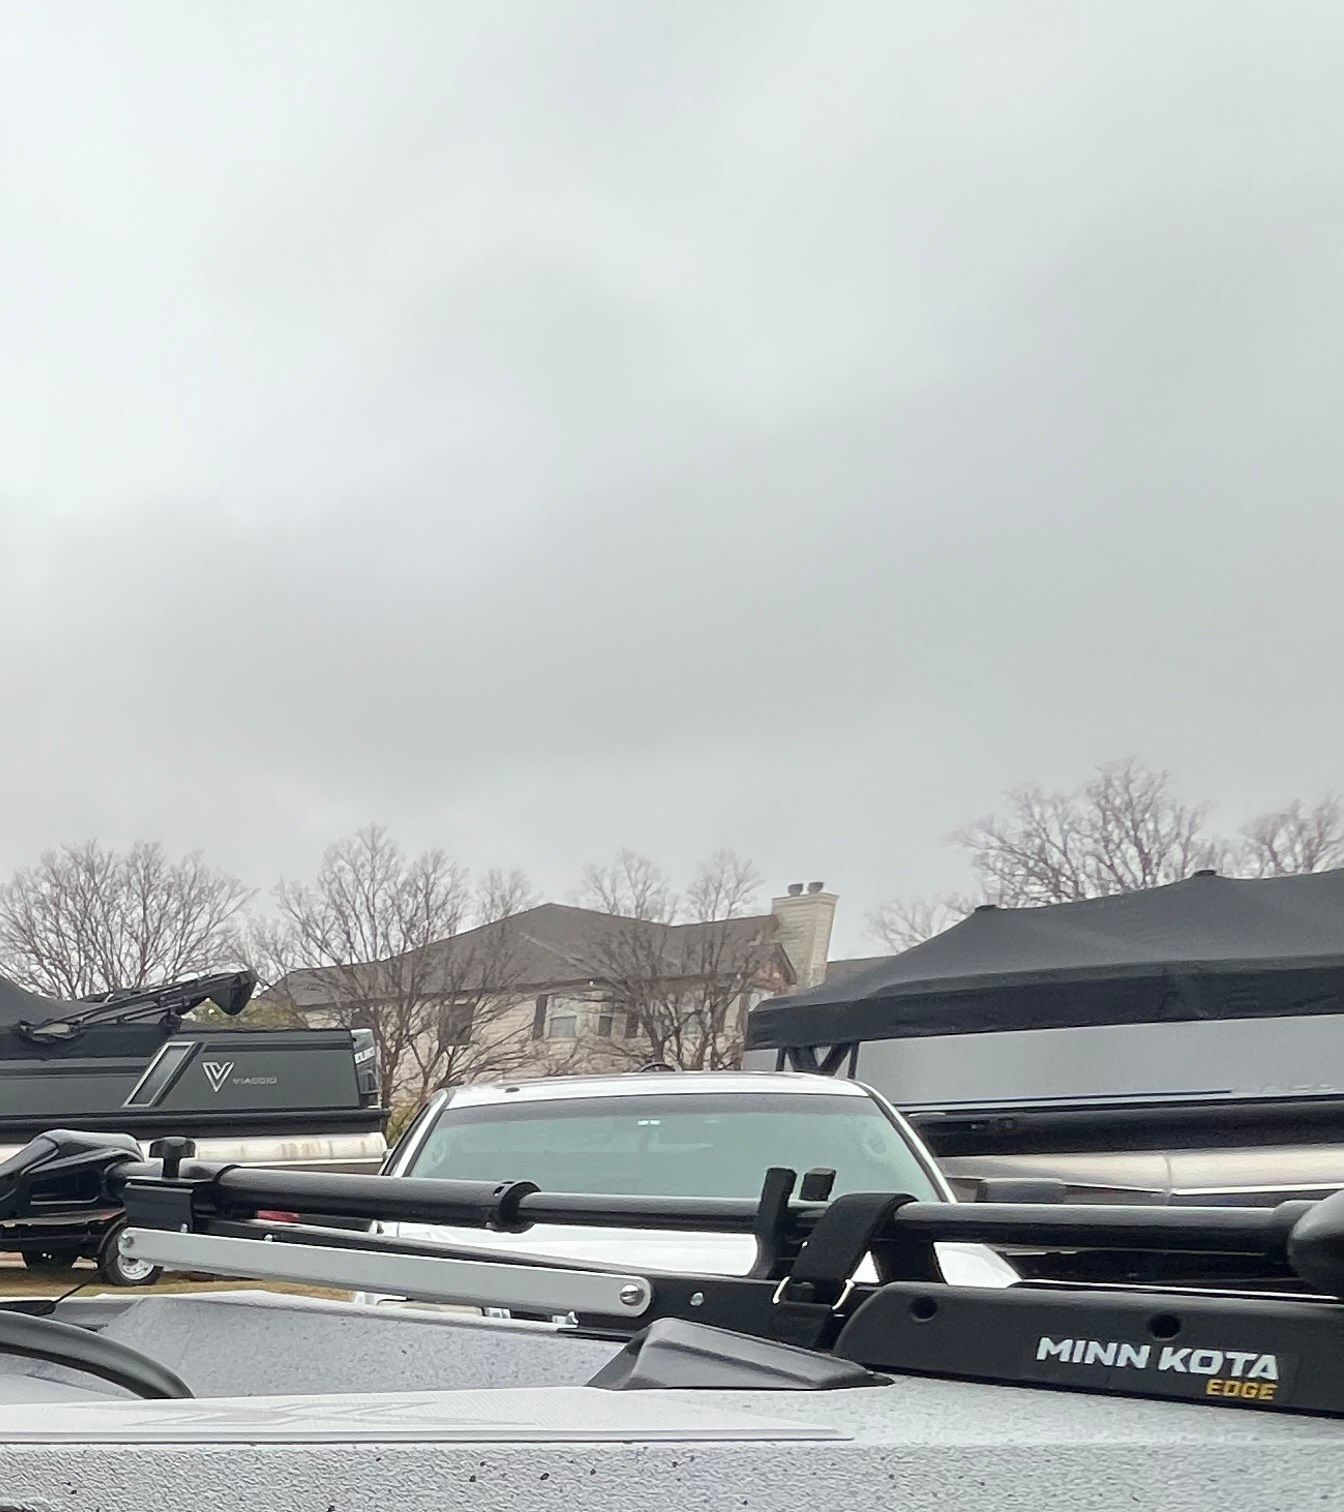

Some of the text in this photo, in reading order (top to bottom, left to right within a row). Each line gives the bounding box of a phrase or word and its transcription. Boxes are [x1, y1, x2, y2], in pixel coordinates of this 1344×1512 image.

[1035, 1336, 1280, 1381] MINN KOTA
[1205, 1378, 1279, 1400] EDGE
